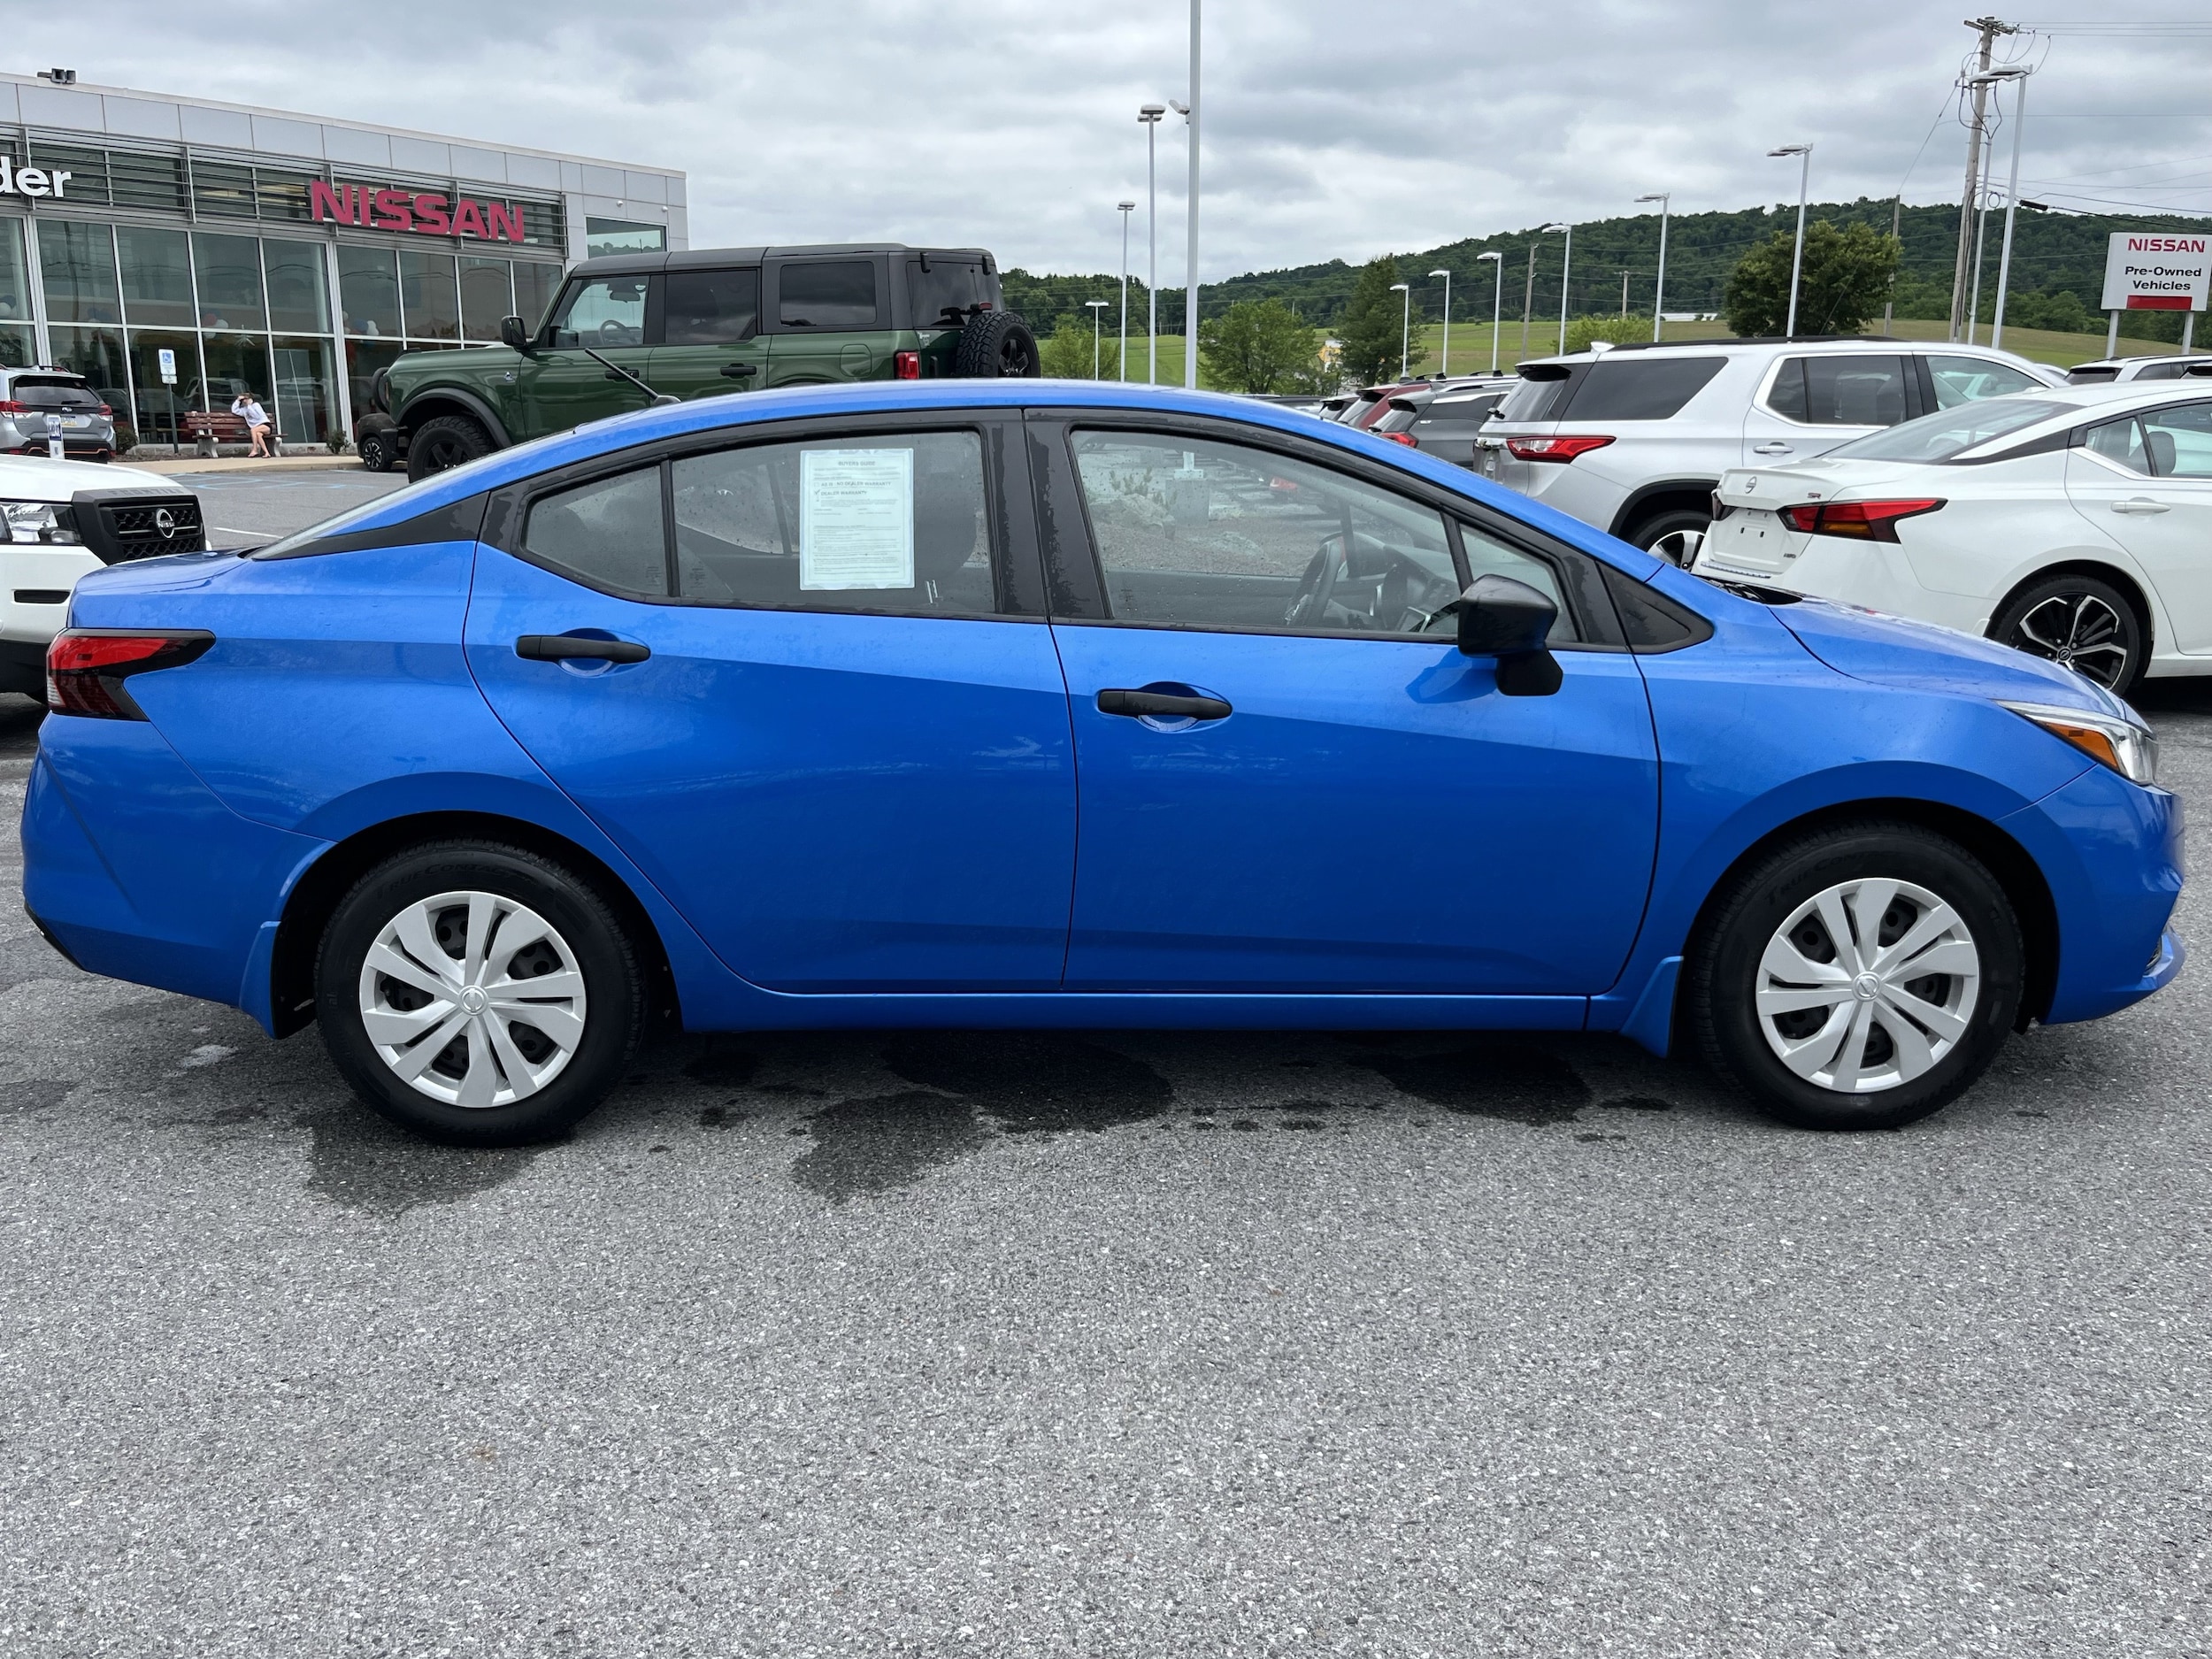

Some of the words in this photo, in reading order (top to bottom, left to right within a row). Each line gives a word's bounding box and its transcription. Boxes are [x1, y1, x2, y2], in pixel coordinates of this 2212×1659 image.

[311, 180, 525, 242] NISSAN
[2128, 238, 2205, 253] NISSAN
[2124, 266, 2202, 276] Pre-Owned
[2132, 280, 2191, 290] Vehicles
